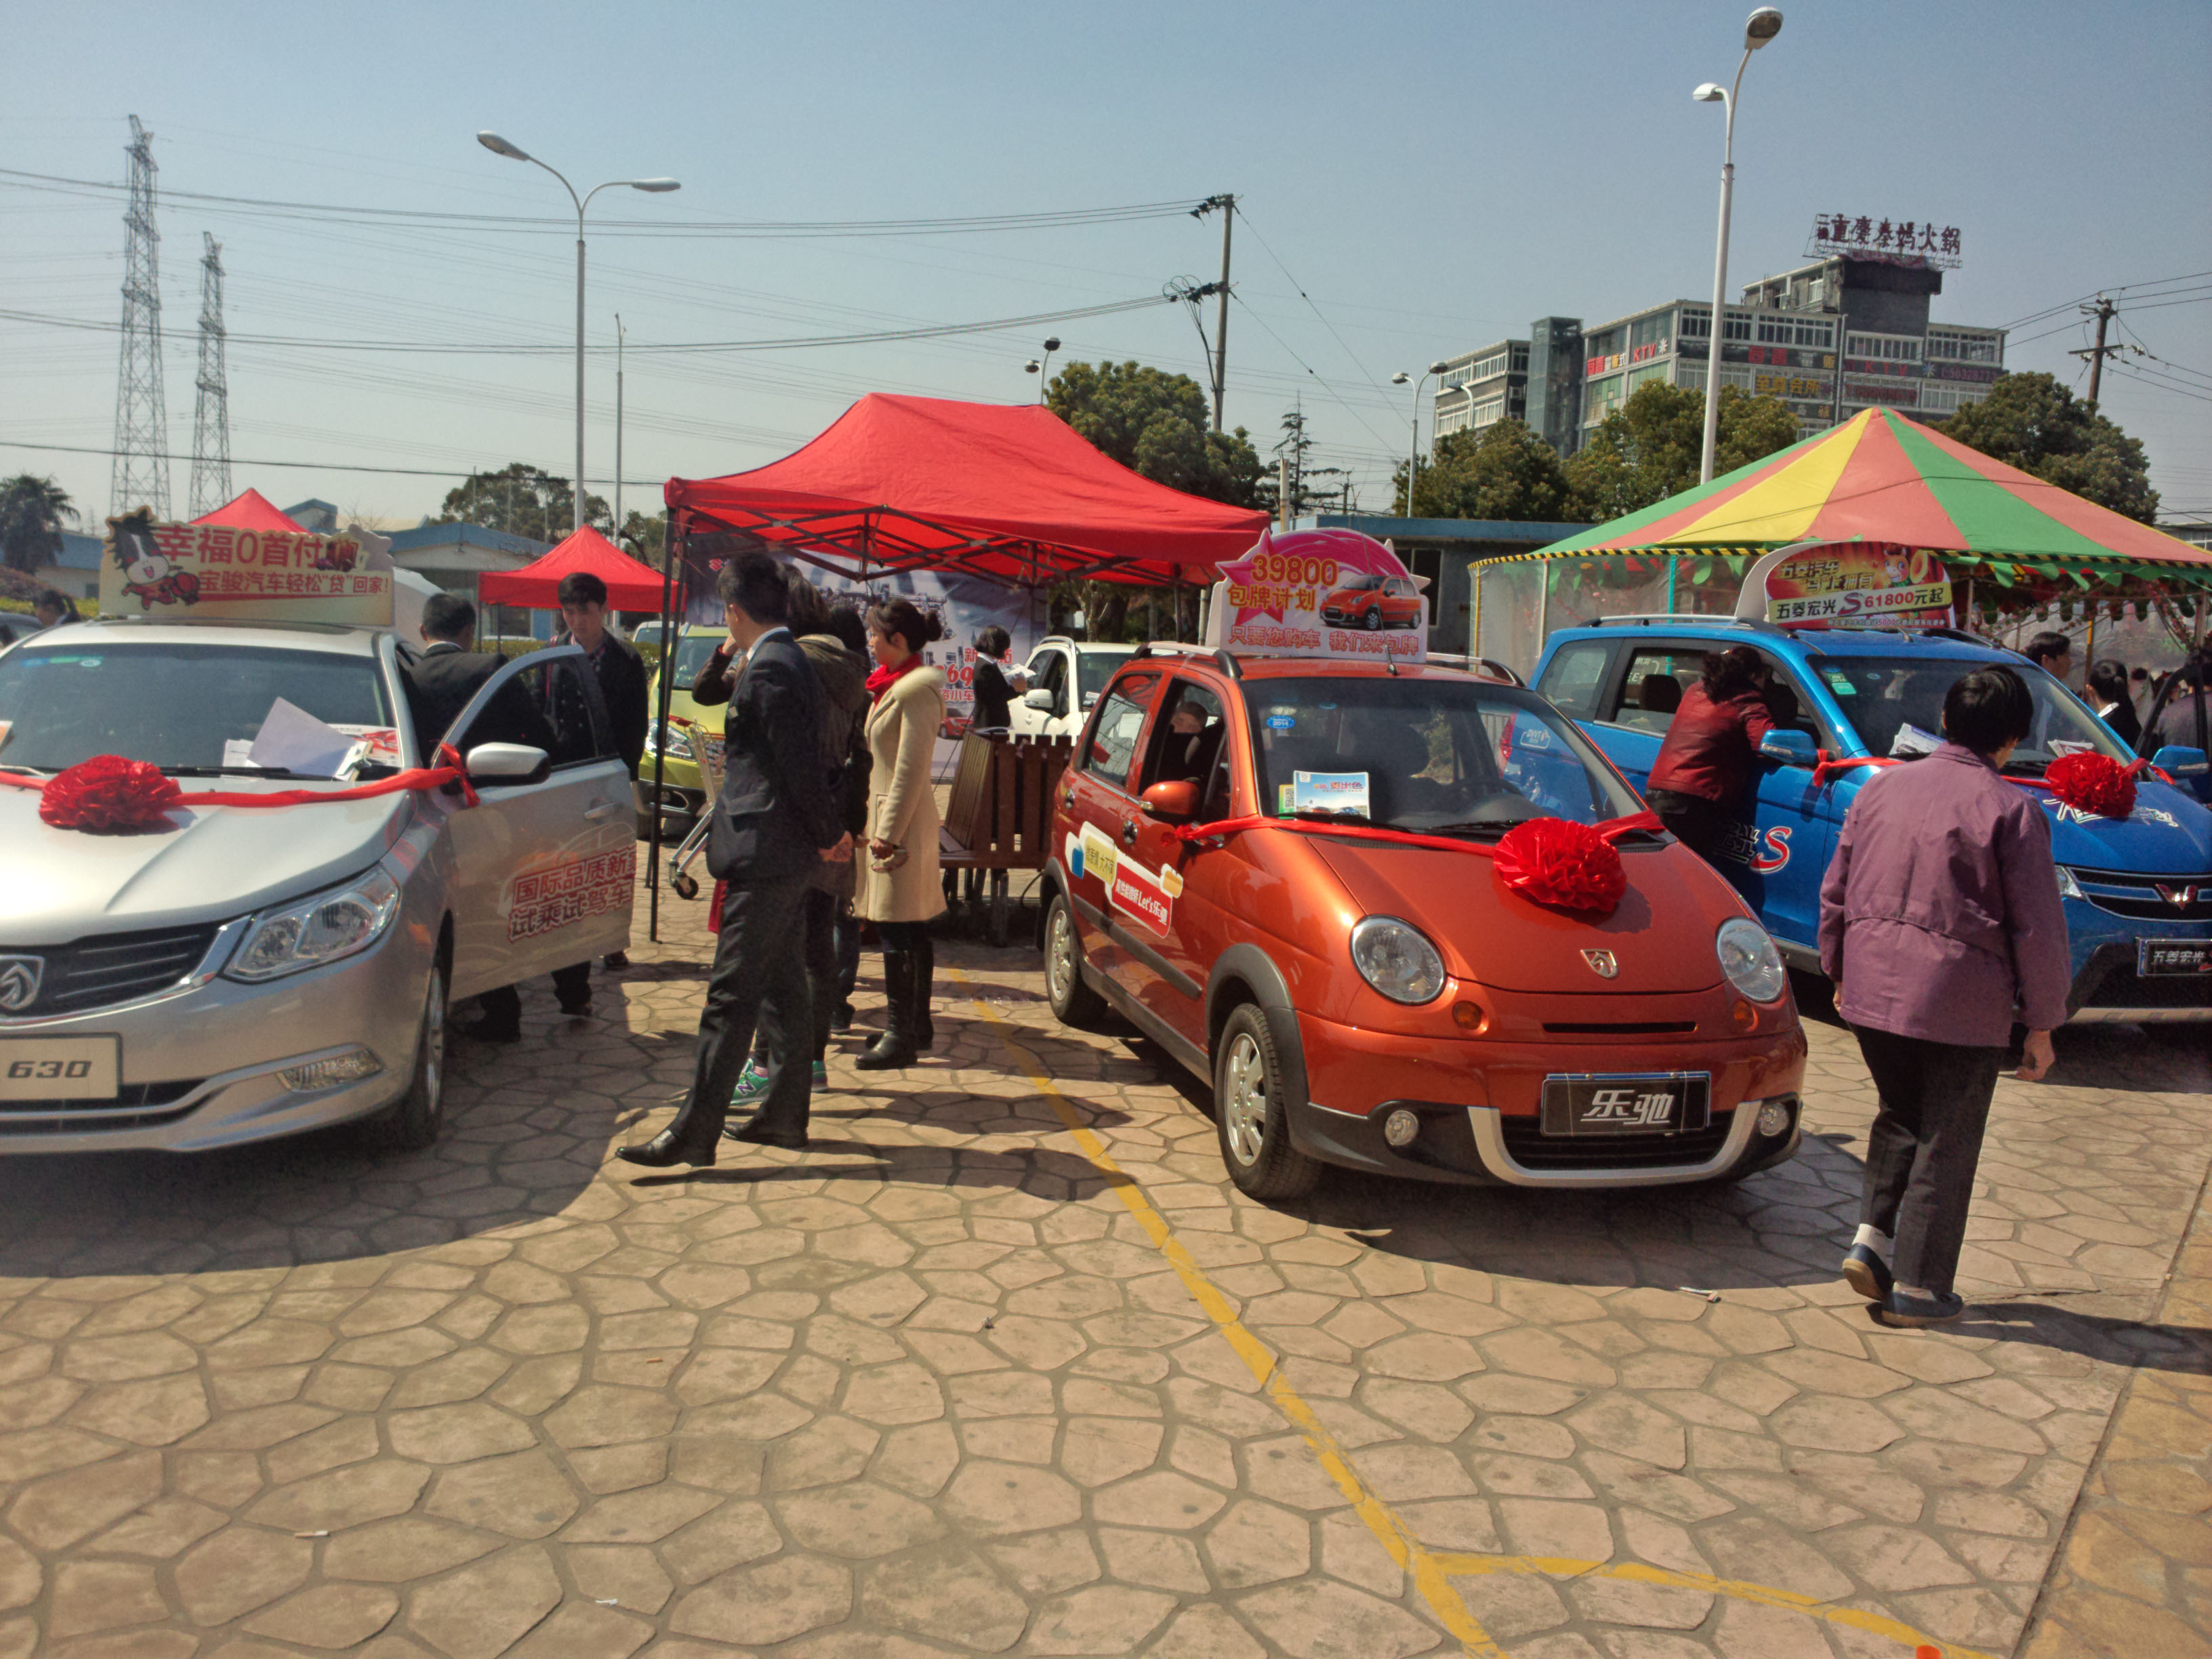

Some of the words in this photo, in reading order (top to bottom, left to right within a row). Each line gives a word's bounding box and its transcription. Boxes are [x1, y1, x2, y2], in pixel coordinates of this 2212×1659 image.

[1633, 343, 1656, 363] KTV
[1865, 361, 1908, 376] KTV
[1251, 554, 1338, 587] 39800
[1227, 584, 1316, 611] 包牌计划
[1777, 599, 1837, 619] 五菱宏光
[1864, 588, 1944, 607] 61800元起
[1229, 626, 1321, 648] 只要您购车
[1329, 632, 1419, 655] 我们来包牌
[511, 884, 632, 937] 试乘试驾车
[7, 1061, 92, 1078] 630
[1580, 1090, 1675, 1125] 乐驰
